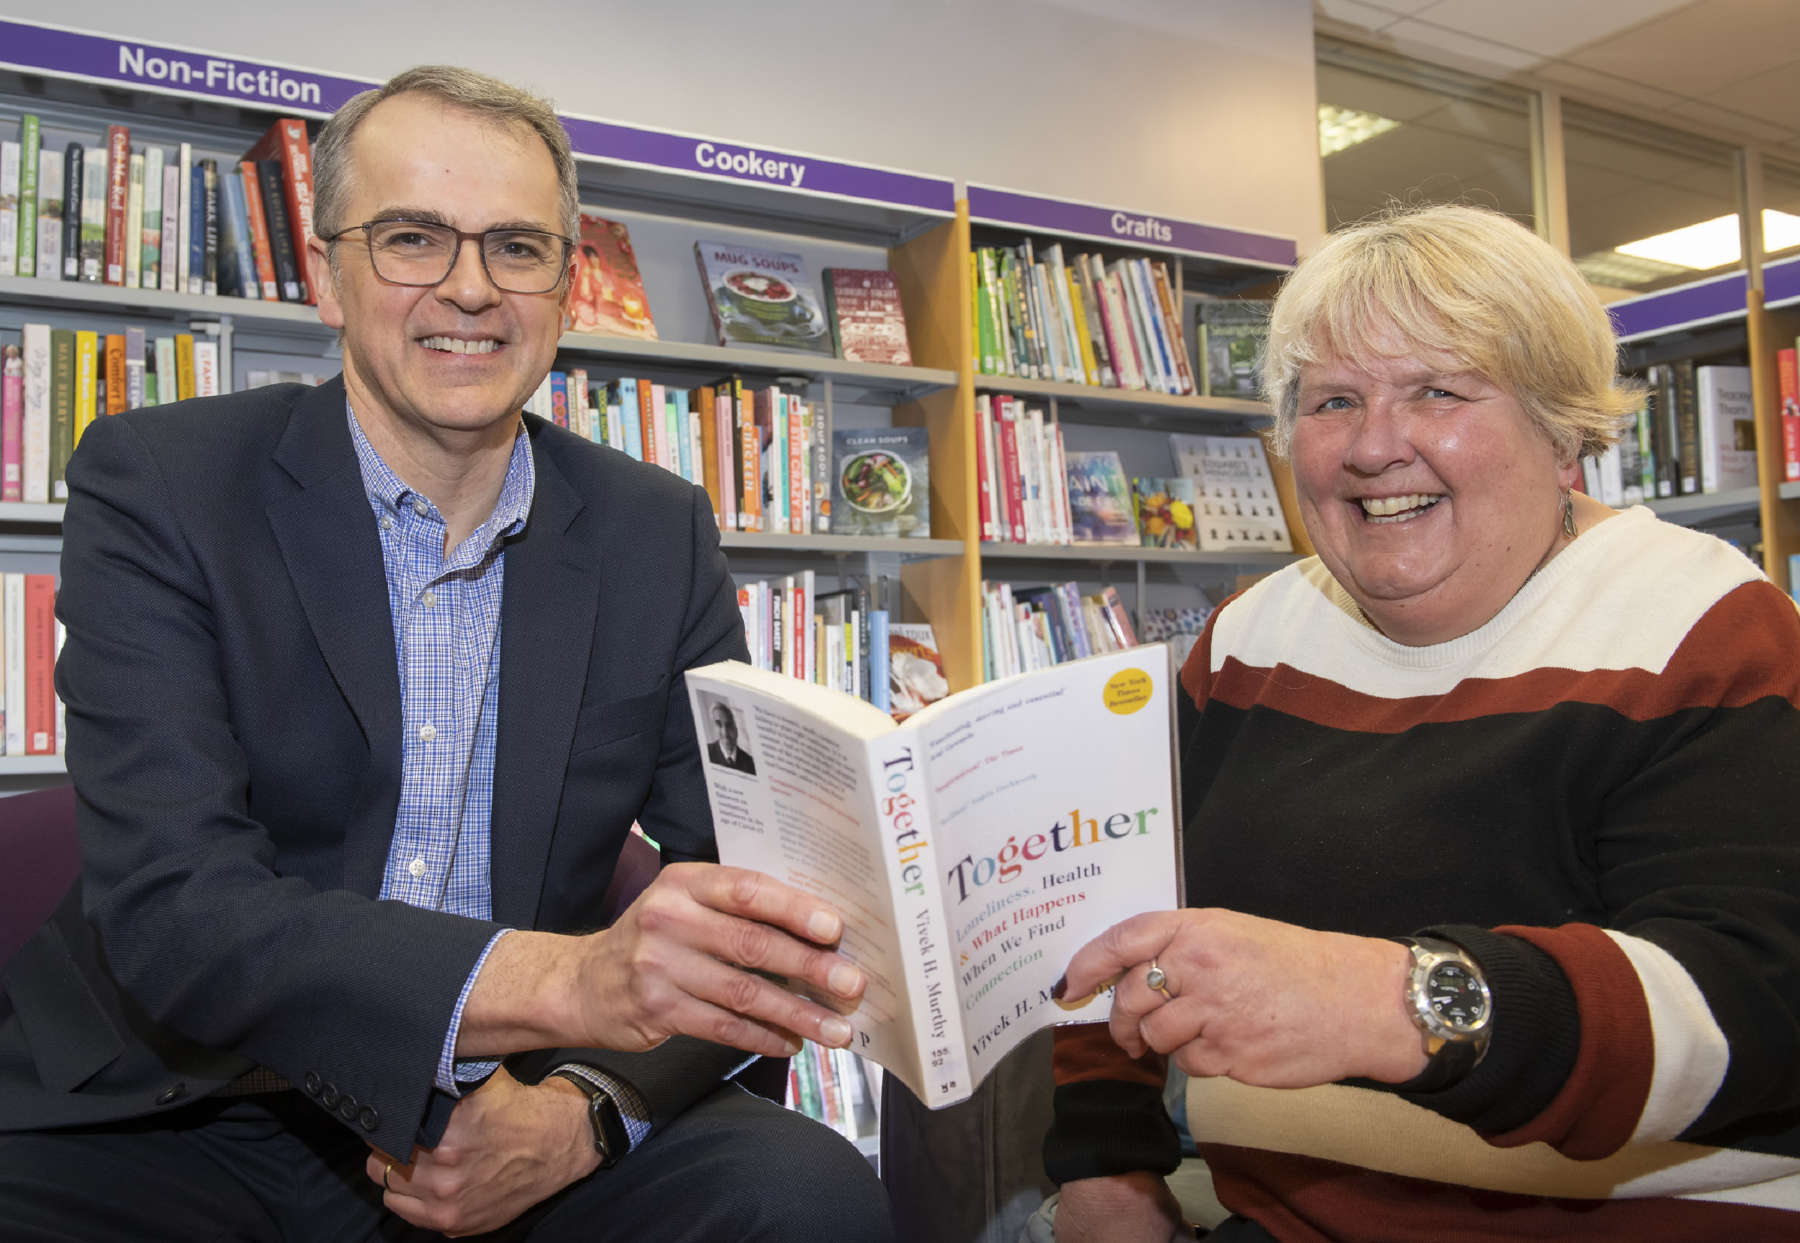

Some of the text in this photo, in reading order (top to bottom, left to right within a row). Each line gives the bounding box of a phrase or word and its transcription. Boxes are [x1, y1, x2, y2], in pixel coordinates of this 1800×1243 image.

[118, 46, 322, 104] Non-Fiction
[694, 142, 806, 188] Cookery
[110, 185, 125, 210] Red
[208, 226, 218, 253] LIFE
[1111, 212, 1173, 243] Crafts
[715, 251, 799, 273] MUG SOUPS
[58, 343, 68, 377] MARY
[109, 348, 123, 400] Comfort
[57, 384, 68, 425] BERRY
[743, 422, 754, 491] CHICKEN
[790, 425, 801, 508] STIR CRAZY
[817, 415, 826, 479] SOUP BOOK
[1069, 474, 1125, 494] AINT
[882, 746, 929, 897] Together
[947, 807, 1159, 906] Together
[1042, 863, 1102, 890] Health
[972, 922, 1008, 950] What
[1013, 890, 1087, 926] Happens
[915, 908, 947, 1039] Vivek H. Murthy
[962, 915, 1066, 987] When We Find
[965, 948, 1044, 1011] Connection
[972, 1014, 1011, 1056] Vivek
[1015, 999, 1033, 1018] H.
